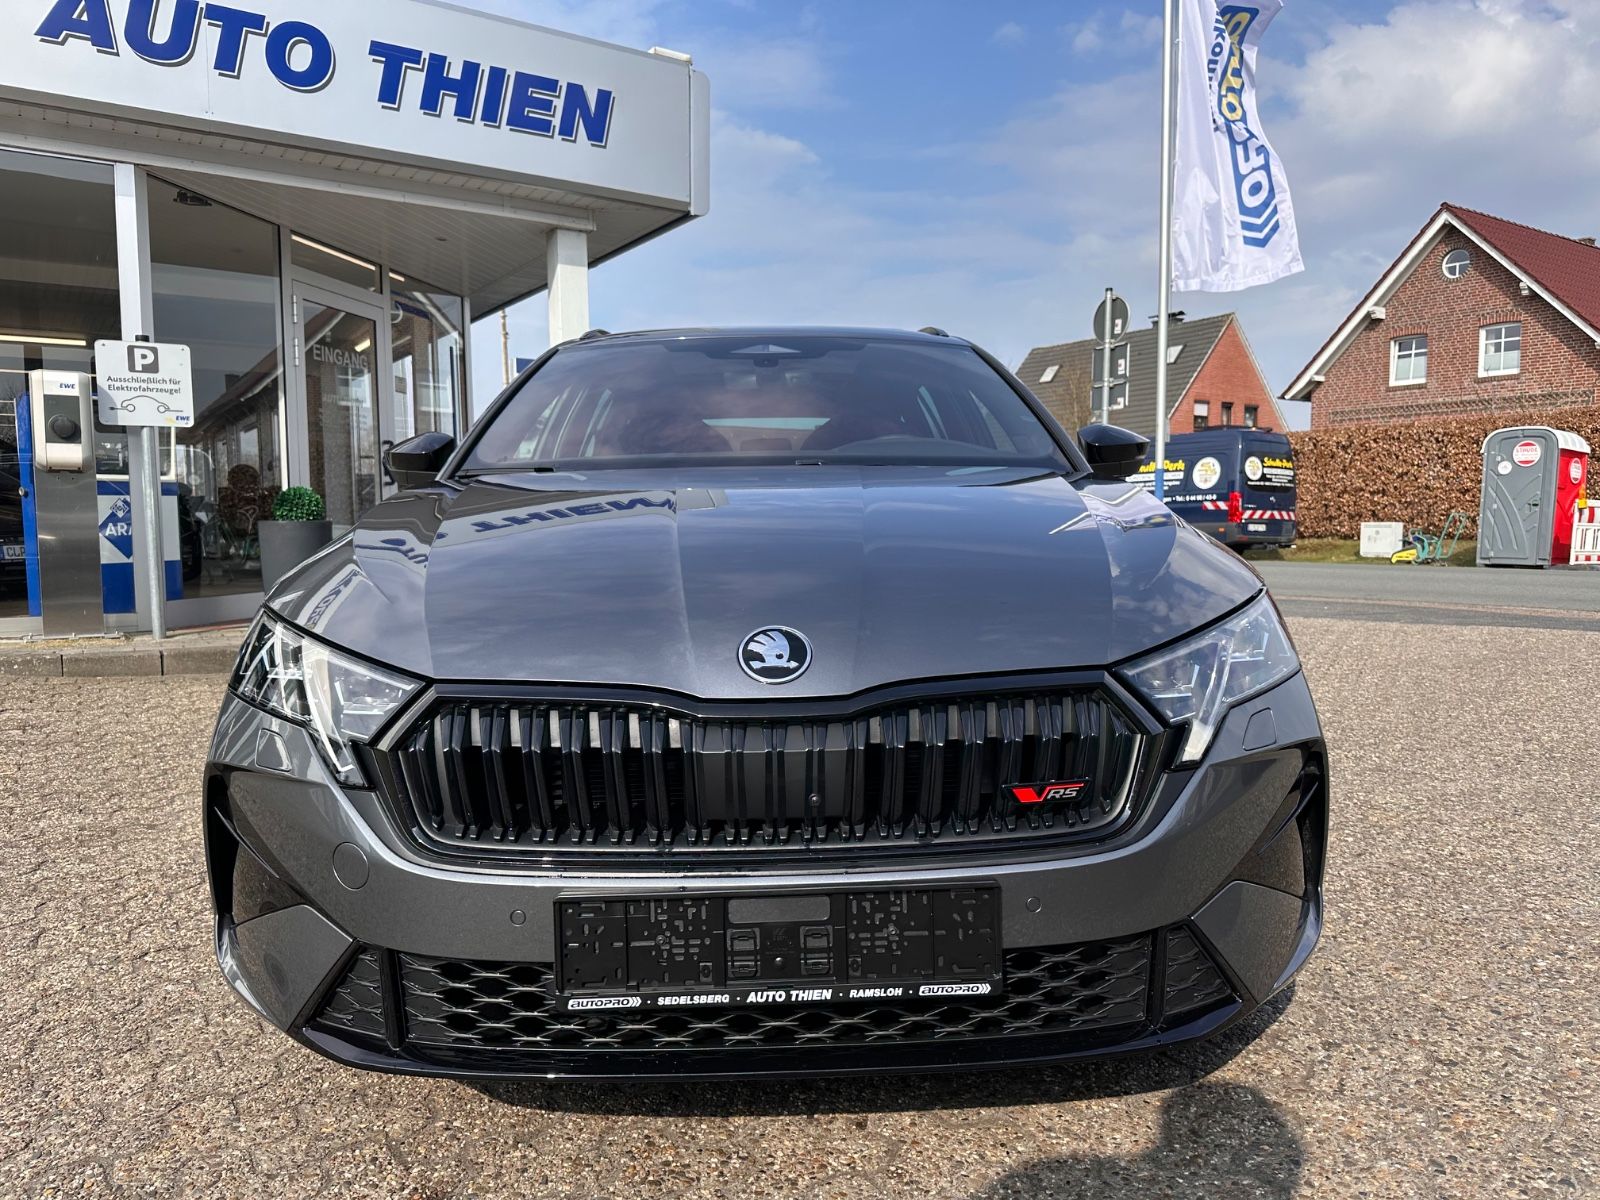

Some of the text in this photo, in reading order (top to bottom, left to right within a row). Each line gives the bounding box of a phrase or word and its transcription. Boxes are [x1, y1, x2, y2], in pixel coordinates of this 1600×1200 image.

[33, 0, 615, 149] AUTO THIEN
[133, 347, 155, 371] P
[313, 343, 369, 370] EINGANG
[59, 382, 76, 390] EWE
[106, 375, 181, 385] Ausschließlich für
[107, 384, 181, 395] Elektrofahrzeuge!
[657, 994, 730, 1006] SEDELSBERG
[746, 990, 786, 1003] AUTO
[790, 989, 833, 1002] THIEN
[849, 987, 903, 998] RAMSLOH
